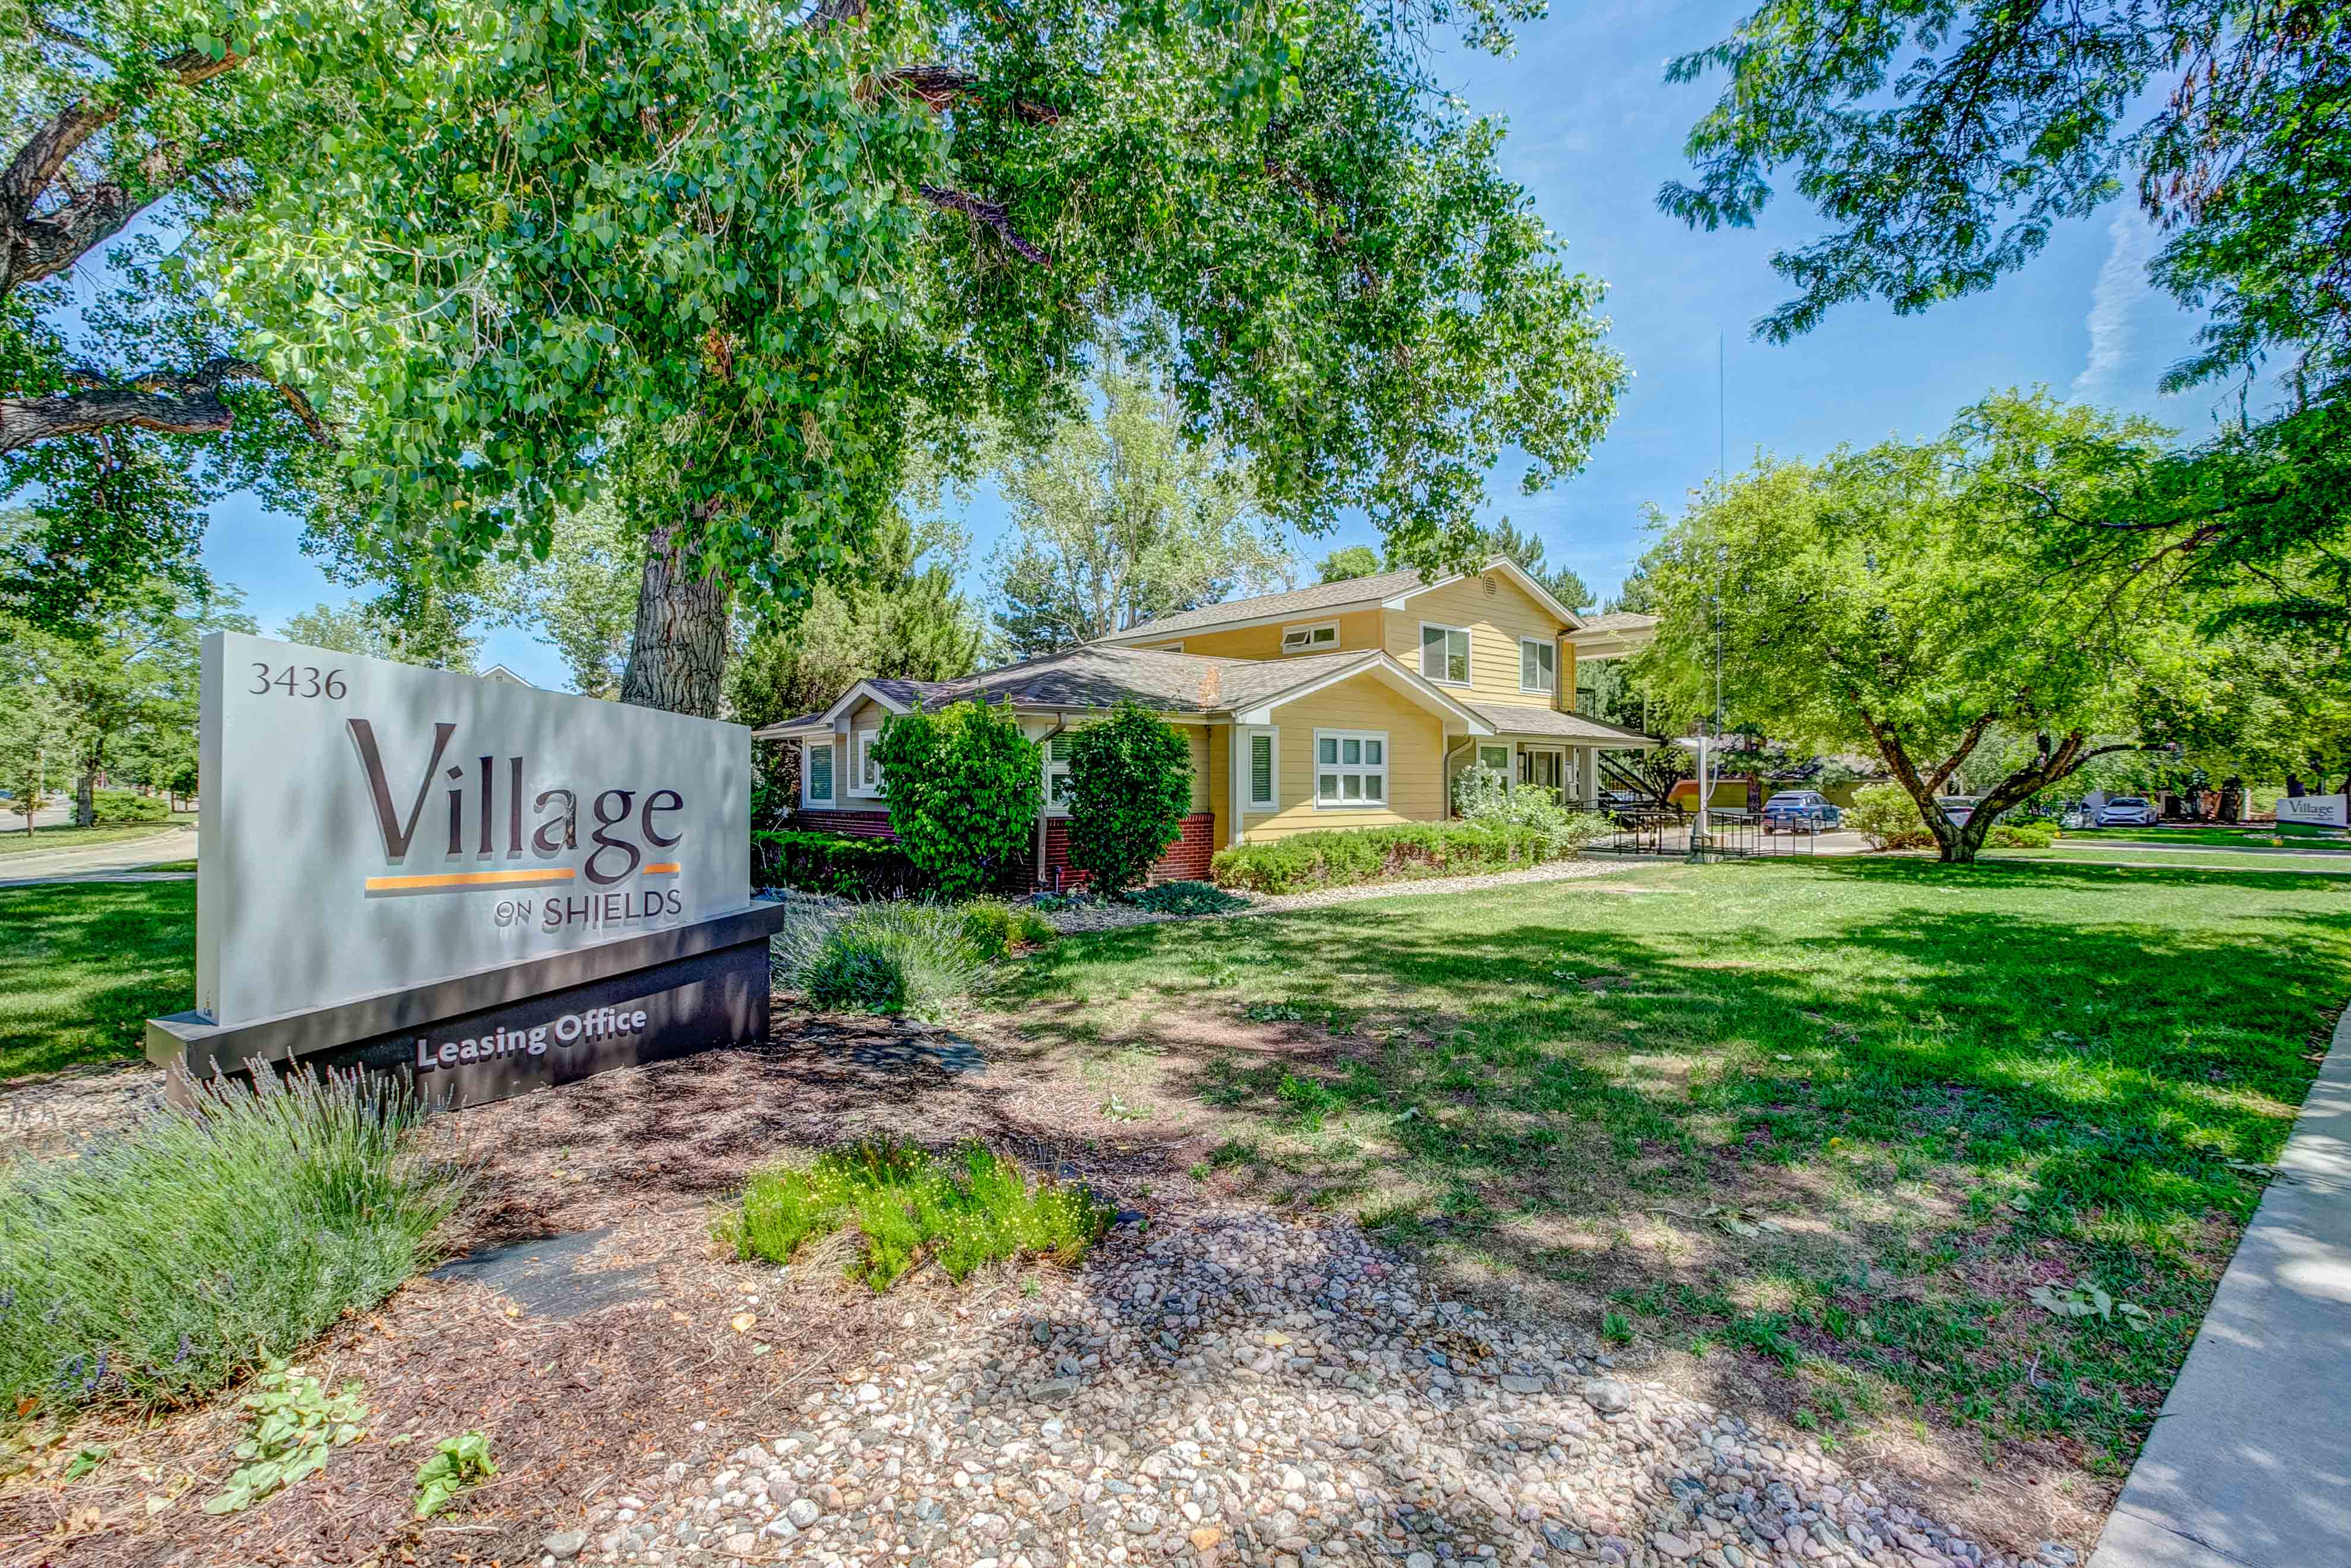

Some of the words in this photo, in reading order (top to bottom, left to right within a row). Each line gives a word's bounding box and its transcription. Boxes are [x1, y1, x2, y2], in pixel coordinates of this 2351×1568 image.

[248, 662, 347, 700] 3436
[346, 718, 684, 885] Village
[2289, 800, 2334, 817] Village
[497, 900, 532, 918] ON
[544, 889, 682, 926] SHIELDS
[417, 1026, 547, 1068] Leasing
[554, 1007, 648, 1041] Office
